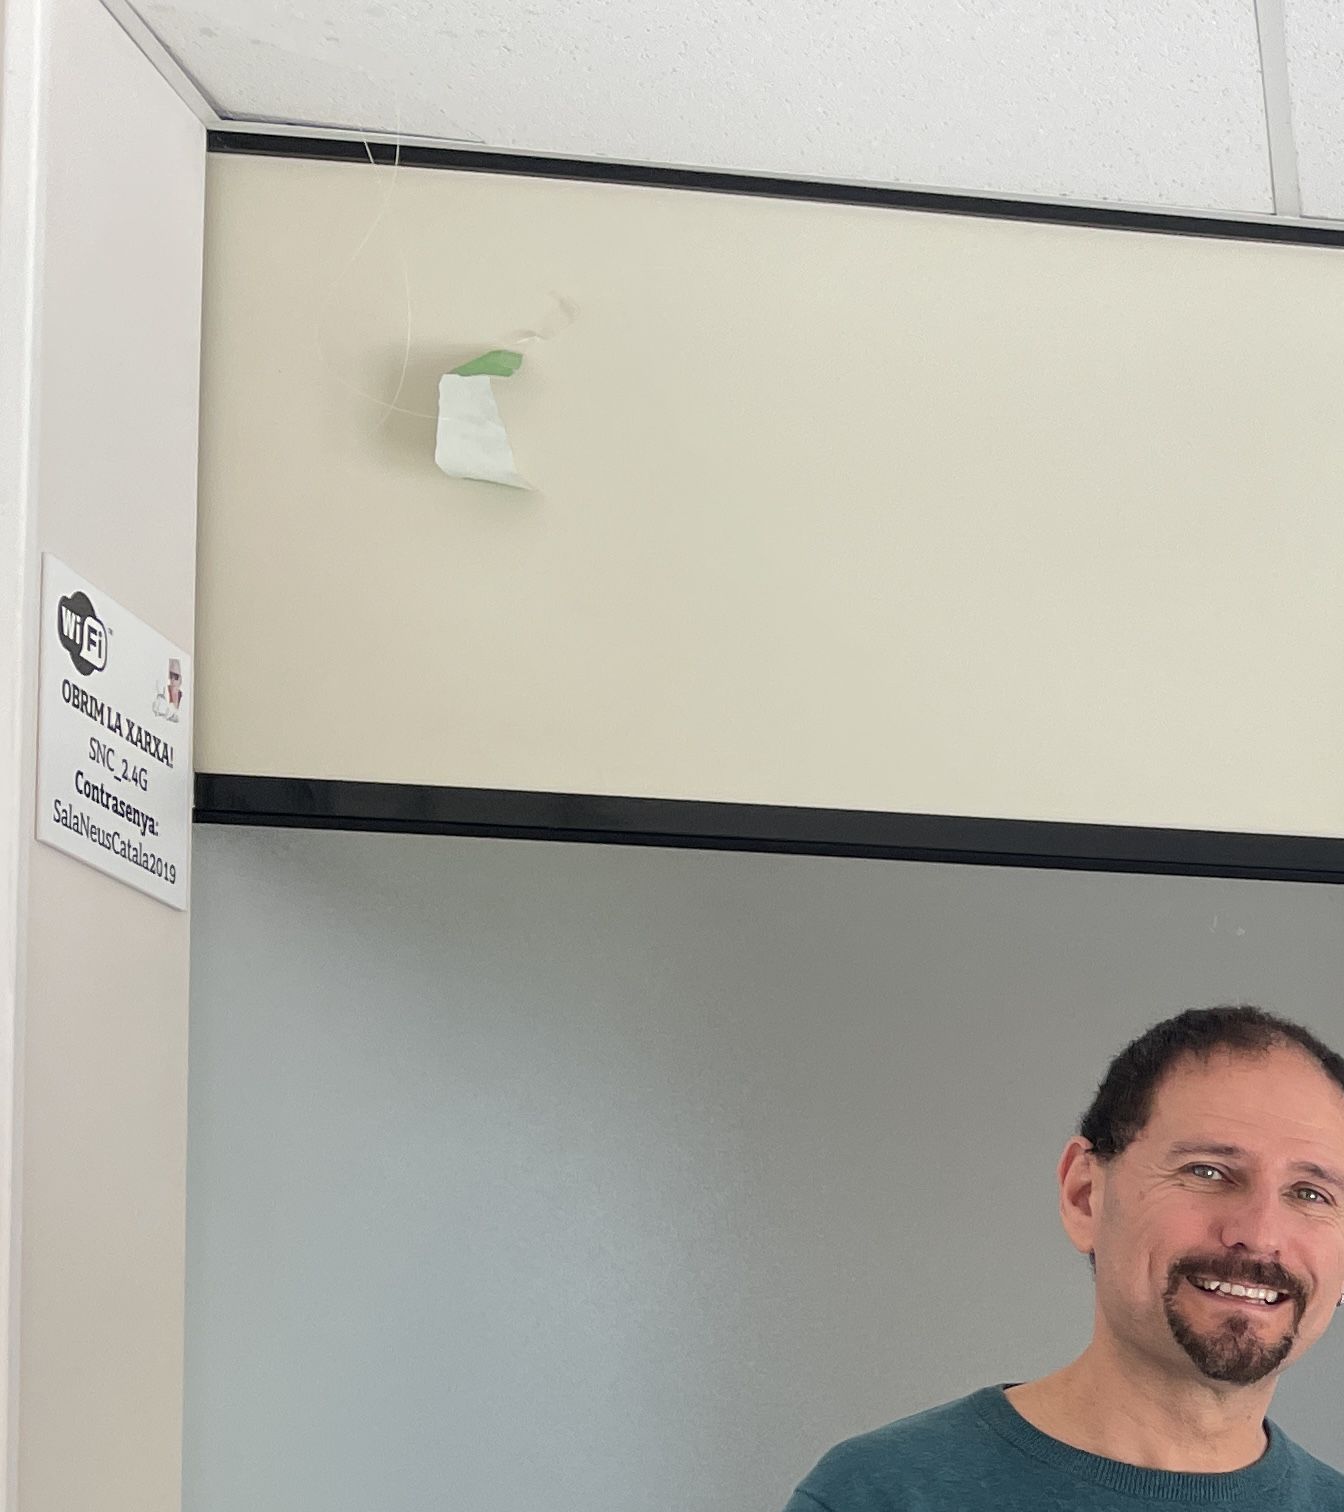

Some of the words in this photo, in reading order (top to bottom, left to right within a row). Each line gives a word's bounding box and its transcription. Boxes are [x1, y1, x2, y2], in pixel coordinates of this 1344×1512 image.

[62, 679, 105, 726] OBRIM
[106, 708, 123, 738] LA
[126, 718, 174, 768] XARXA!
[88, 736, 148, 792] SNC_2.4G
[53, 799, 176, 884] SalaNeusCatala2019
[75, 770, 159, 837] Contrasenya:
